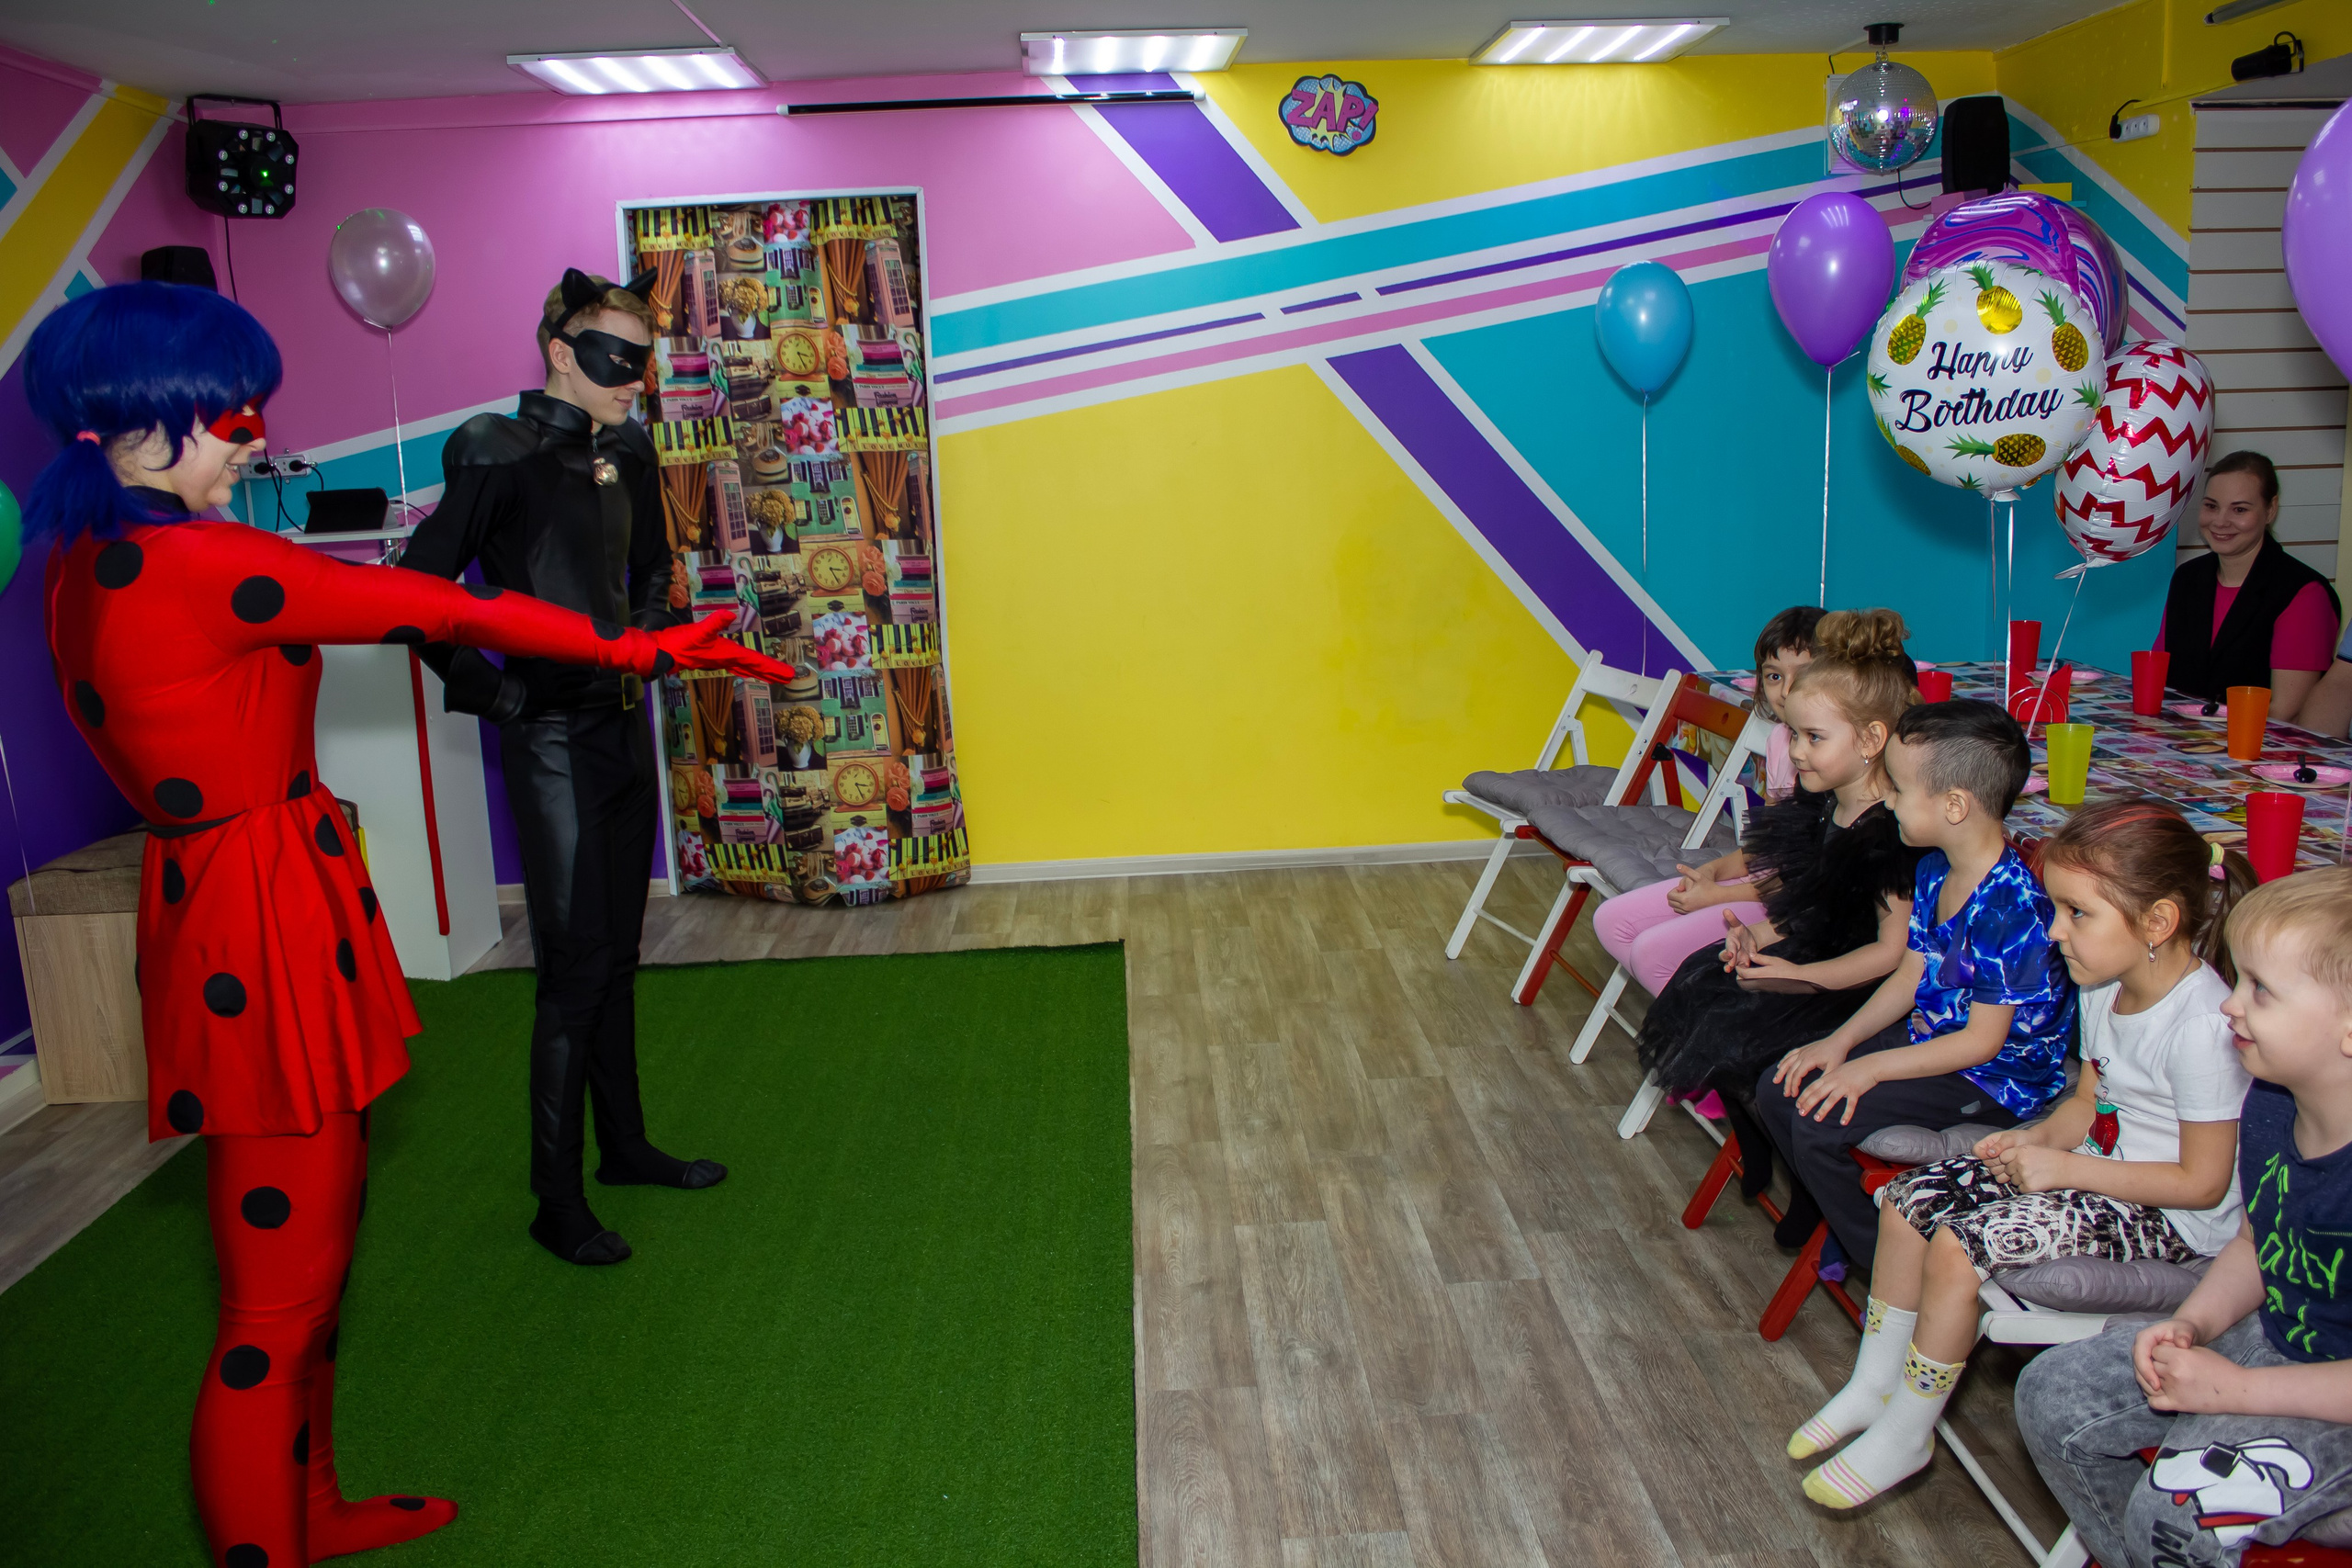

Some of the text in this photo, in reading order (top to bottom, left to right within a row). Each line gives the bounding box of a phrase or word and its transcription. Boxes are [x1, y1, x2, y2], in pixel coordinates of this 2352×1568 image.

[1286, 88, 1379, 141] ZAP!
[1927, 341, 2034, 380] Happy
[1894, 387, 2064, 433] Birthday
